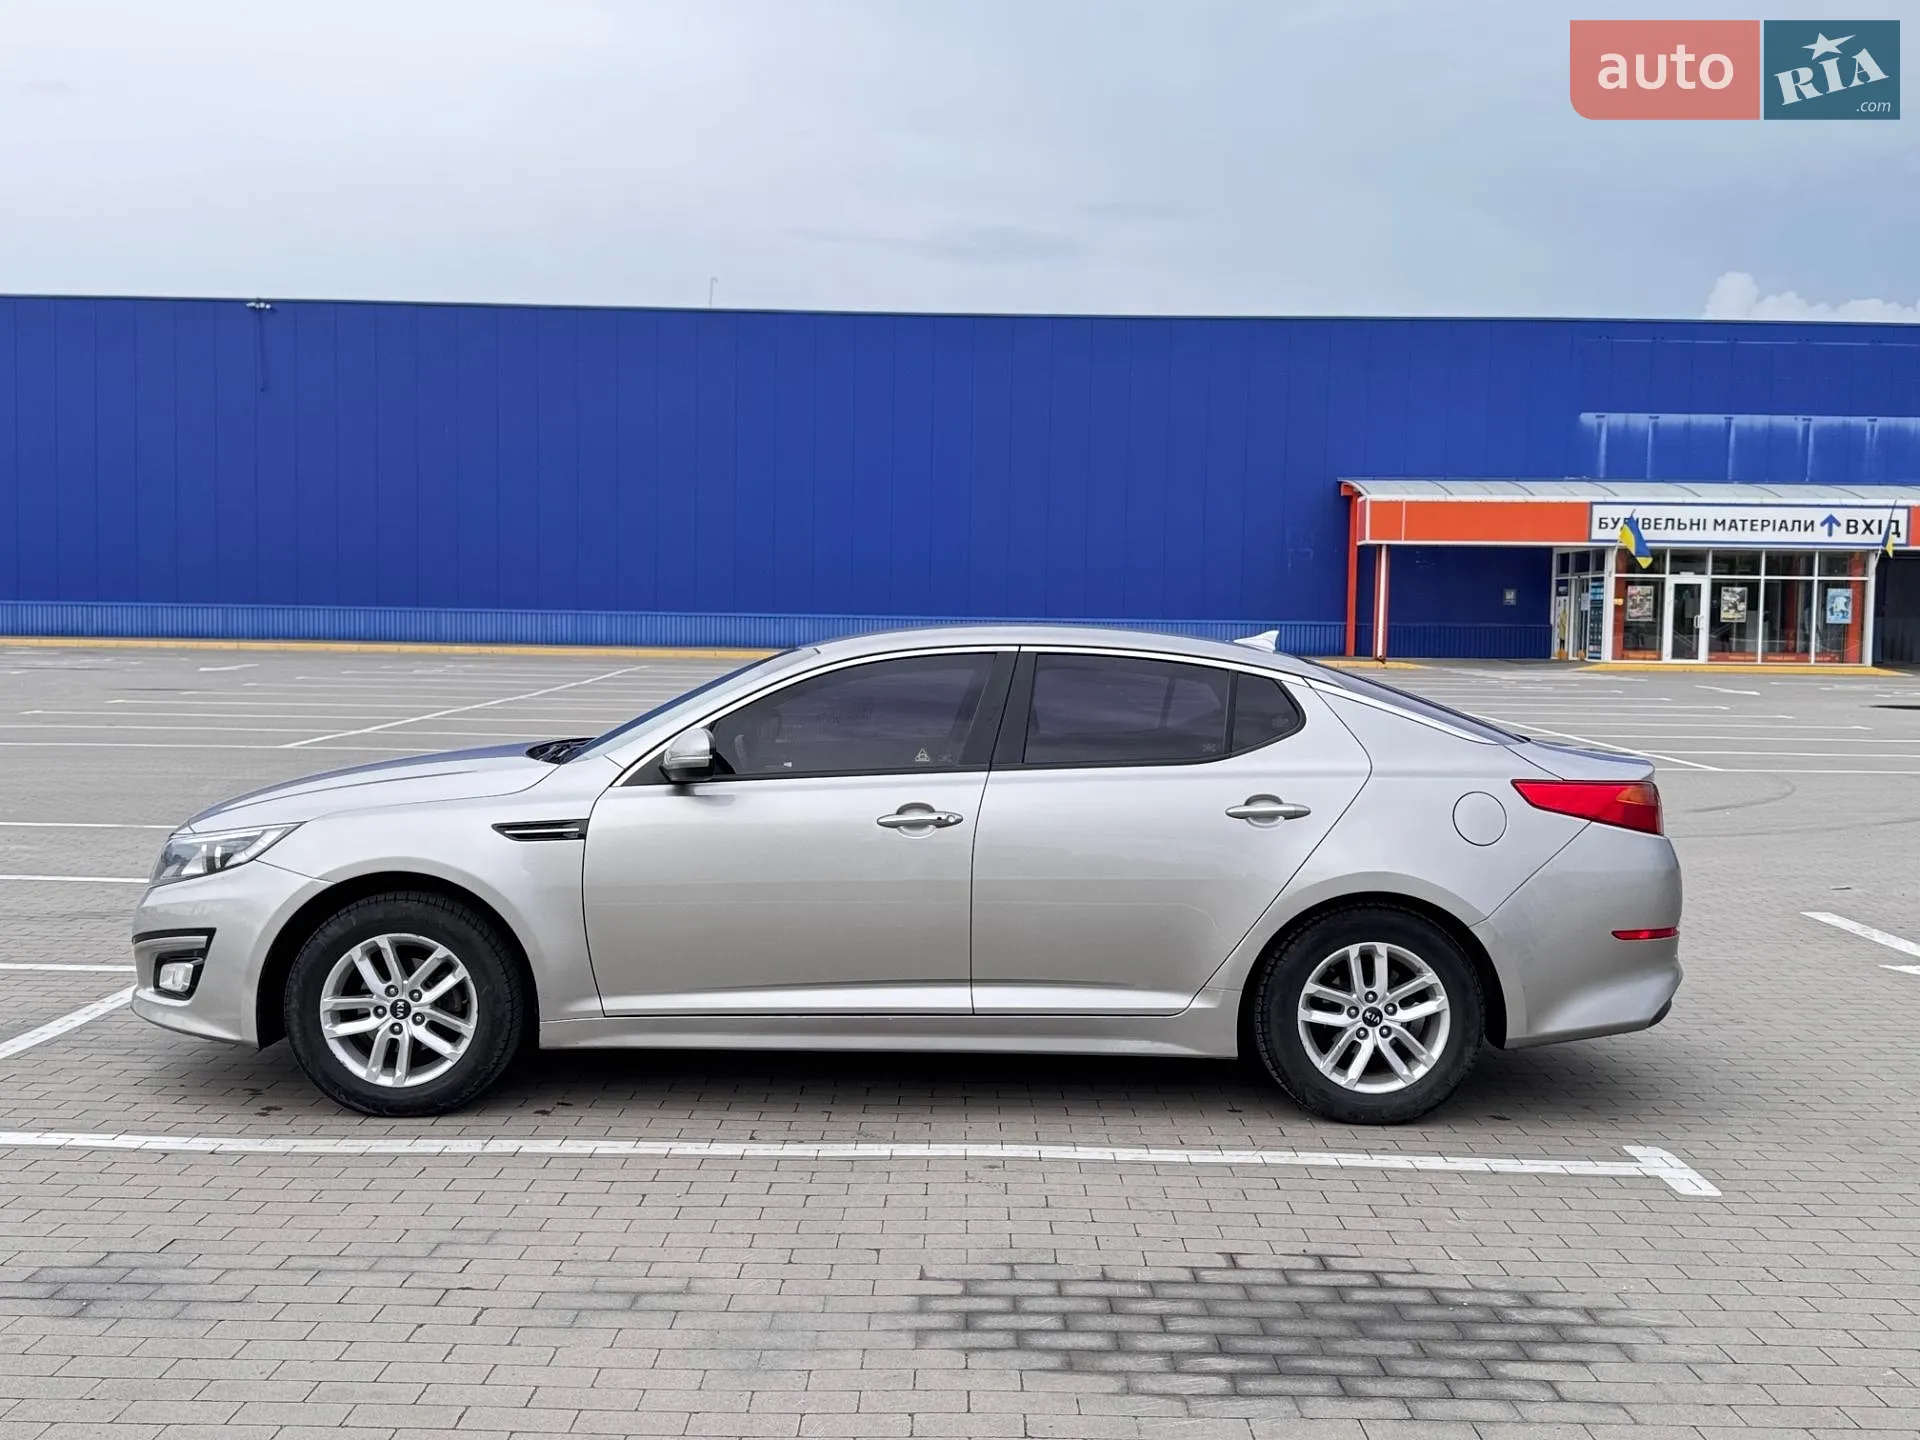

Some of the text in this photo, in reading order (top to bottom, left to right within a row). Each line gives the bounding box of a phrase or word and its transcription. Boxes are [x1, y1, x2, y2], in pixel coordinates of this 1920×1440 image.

[1598, 517, 1707, 531] БУІВЕЛЬНІ
[1713, 518, 1815, 533] МАТЕРІАЛИ
[396, 1001, 405, 1018] KIA
[1364, 1011, 1380, 1024] KIA
